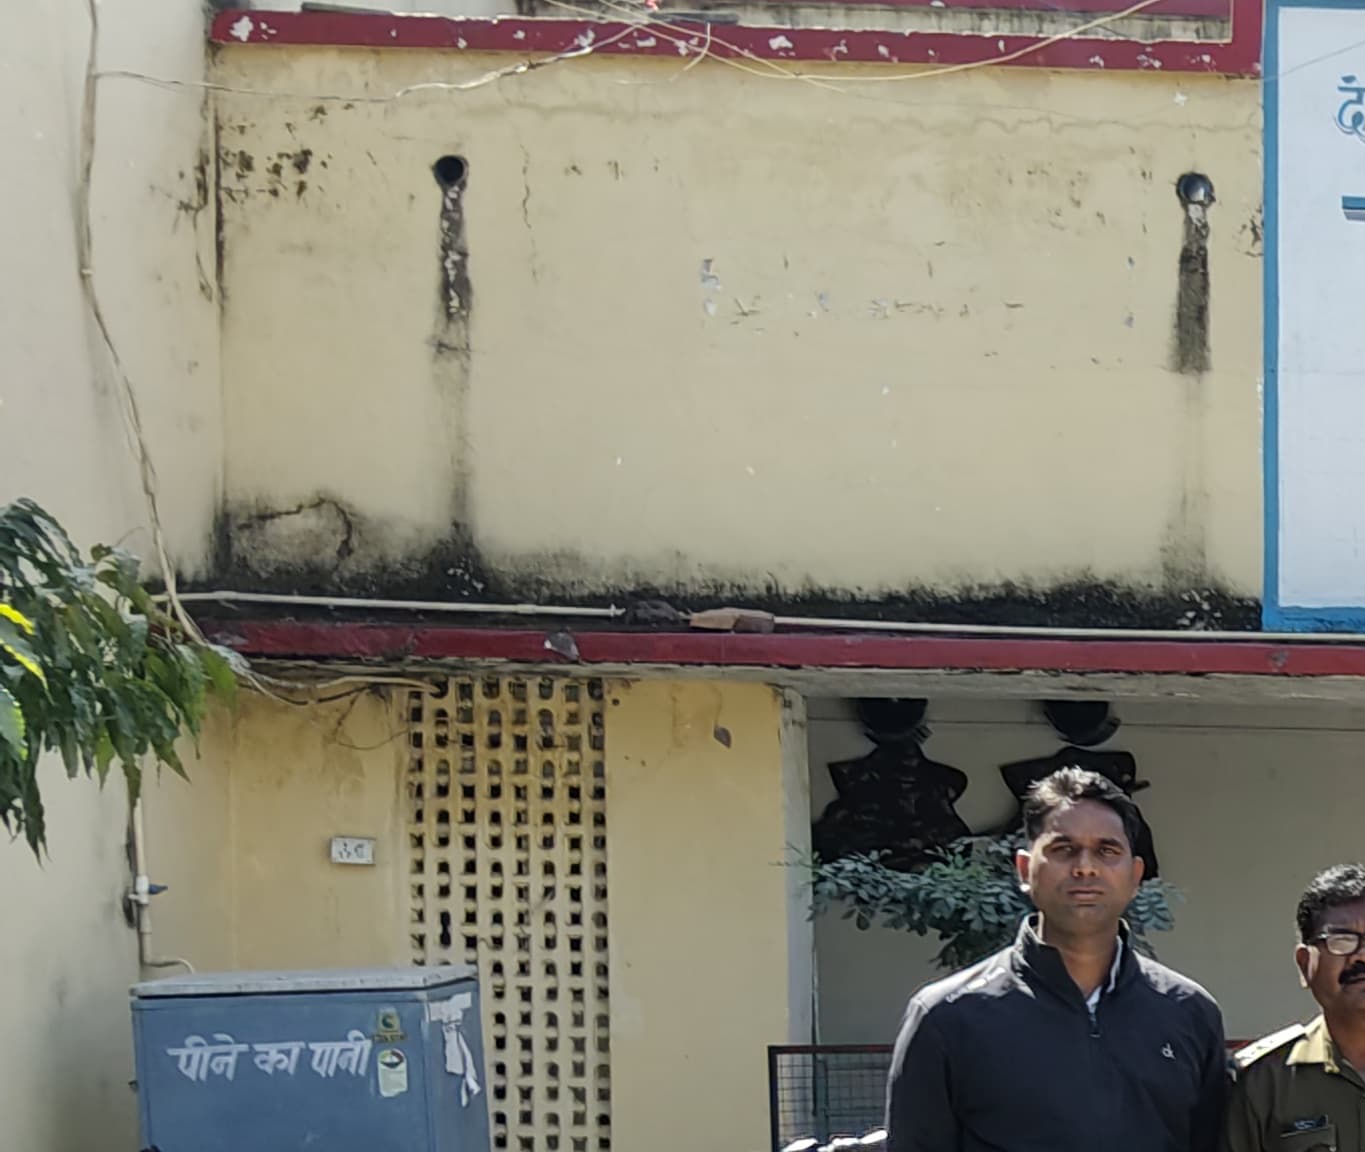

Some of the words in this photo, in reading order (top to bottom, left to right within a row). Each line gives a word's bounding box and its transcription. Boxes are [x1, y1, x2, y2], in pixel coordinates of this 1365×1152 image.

[167, 1034, 249, 1082] पीने
[252, 1041, 306, 1076] का
[308, 1029, 373, 1078] पानी
